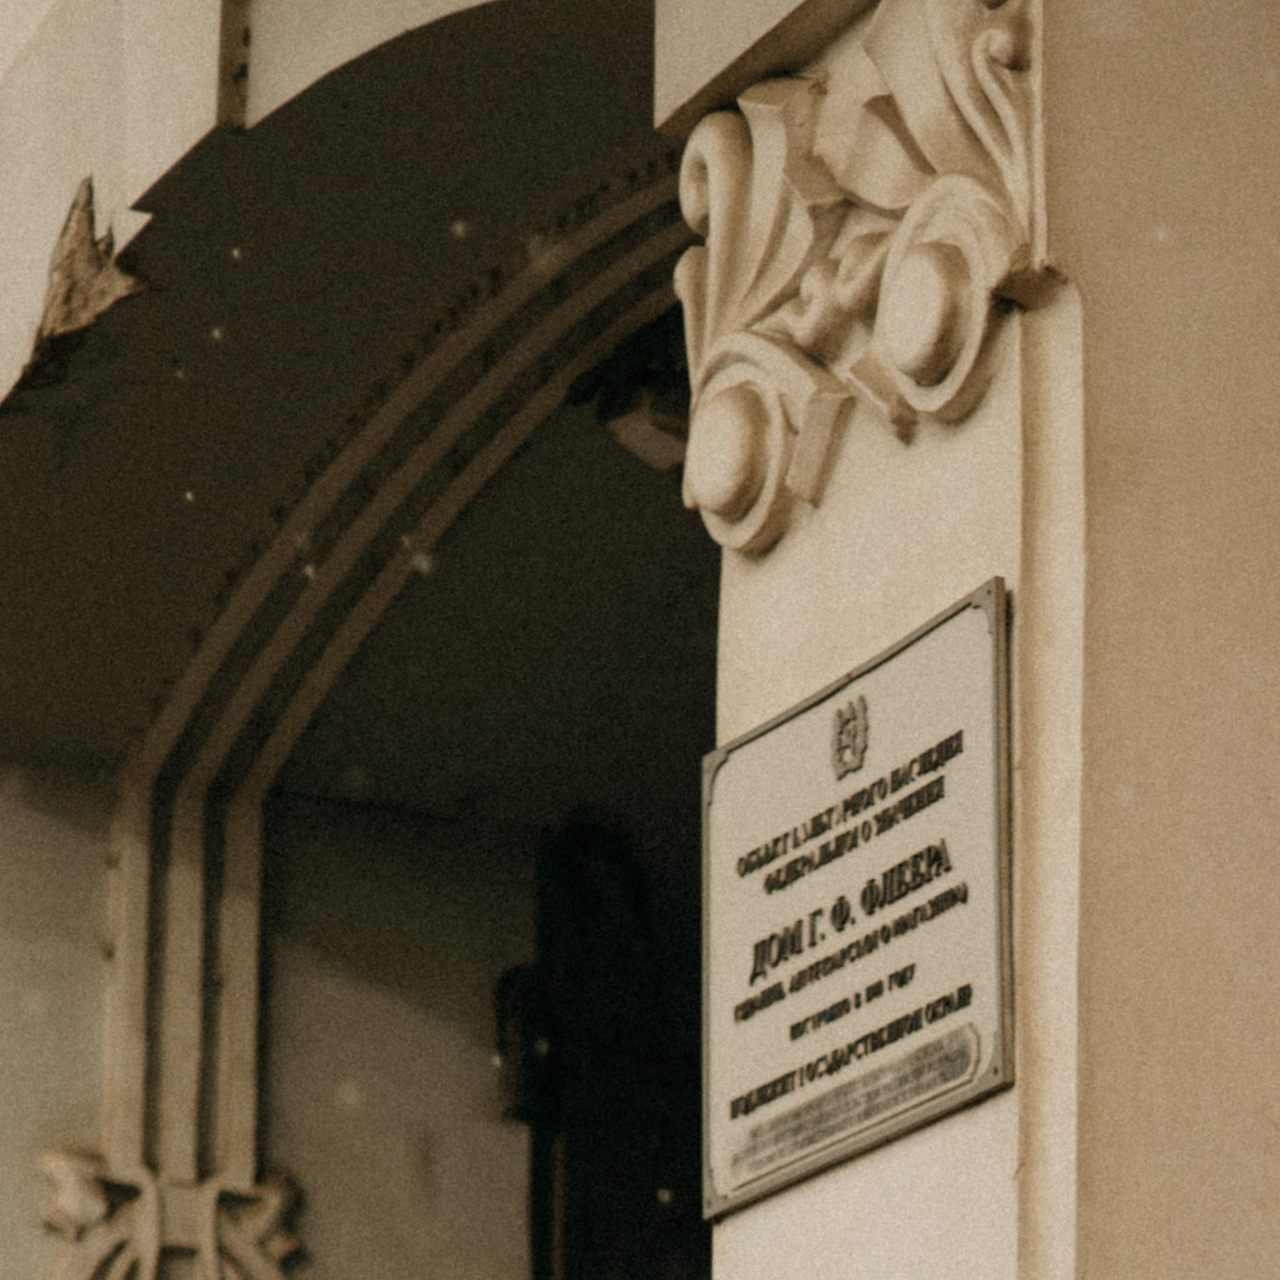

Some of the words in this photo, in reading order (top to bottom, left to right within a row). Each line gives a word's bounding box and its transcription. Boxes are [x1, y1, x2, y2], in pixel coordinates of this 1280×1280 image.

[750, 919, 803, 987] ДОМ
[808, 908, 825, 947] Г.
[831, 896, 855, 932] Ф.
[861, 838, 952, 916] ФЛЕЕРА
